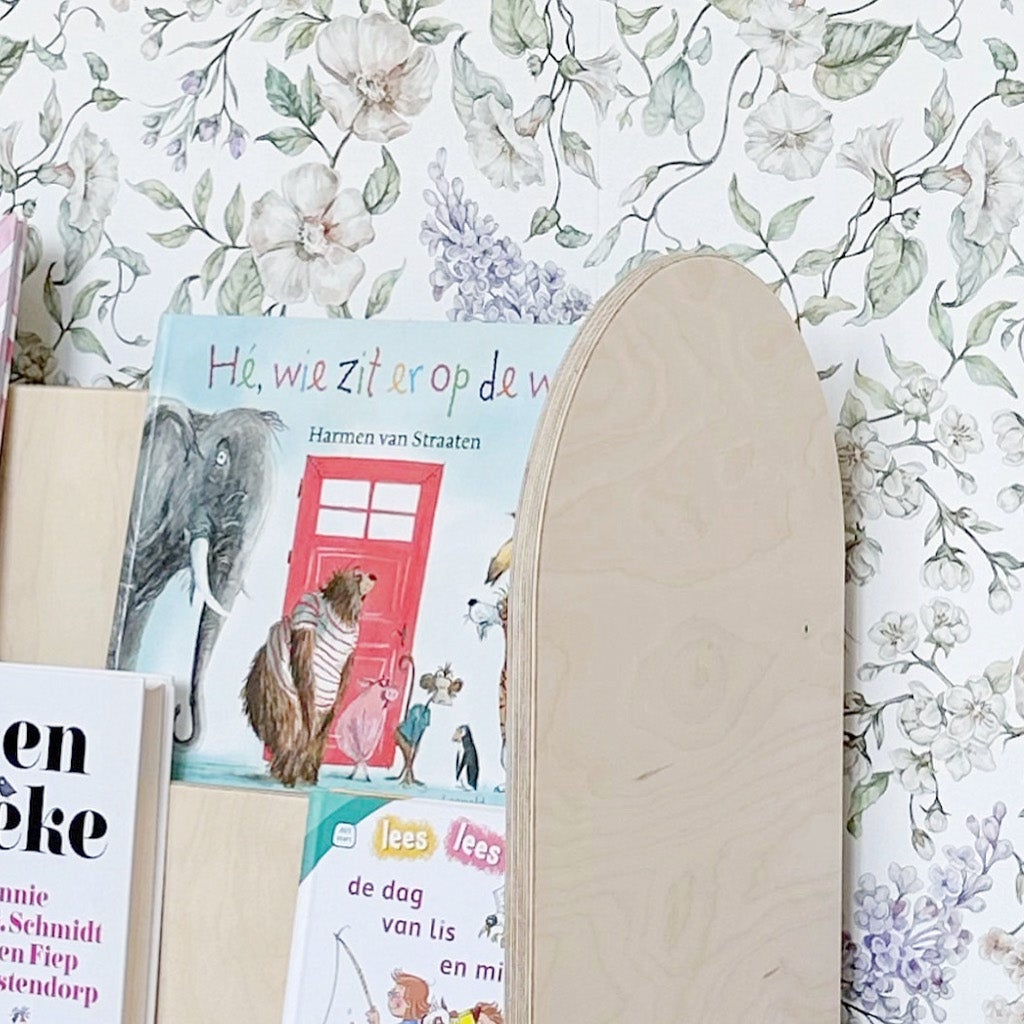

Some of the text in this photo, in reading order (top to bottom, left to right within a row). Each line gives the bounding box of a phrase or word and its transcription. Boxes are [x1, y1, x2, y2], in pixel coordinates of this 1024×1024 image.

[208, 343, 262, 395] Hé,
[274, 349, 327, 392] wie
[336, 346, 382, 398] zit
[391, 361, 426, 395] er
[430, 363, 470, 417] op
[479, 349, 518, 402] de
[308, 426, 481, 450] Harmen van Straaten
[2, 720, 90, 776] en
[381, 817, 502, 866] lees lees
[348, 876, 424, 910] de dag
[8, 910, 103, 944] Schmidt
[382, 916, 456, 942] van lis
[29, 943, 79, 976] Fiep
[440, 958, 504, 982] en mi
